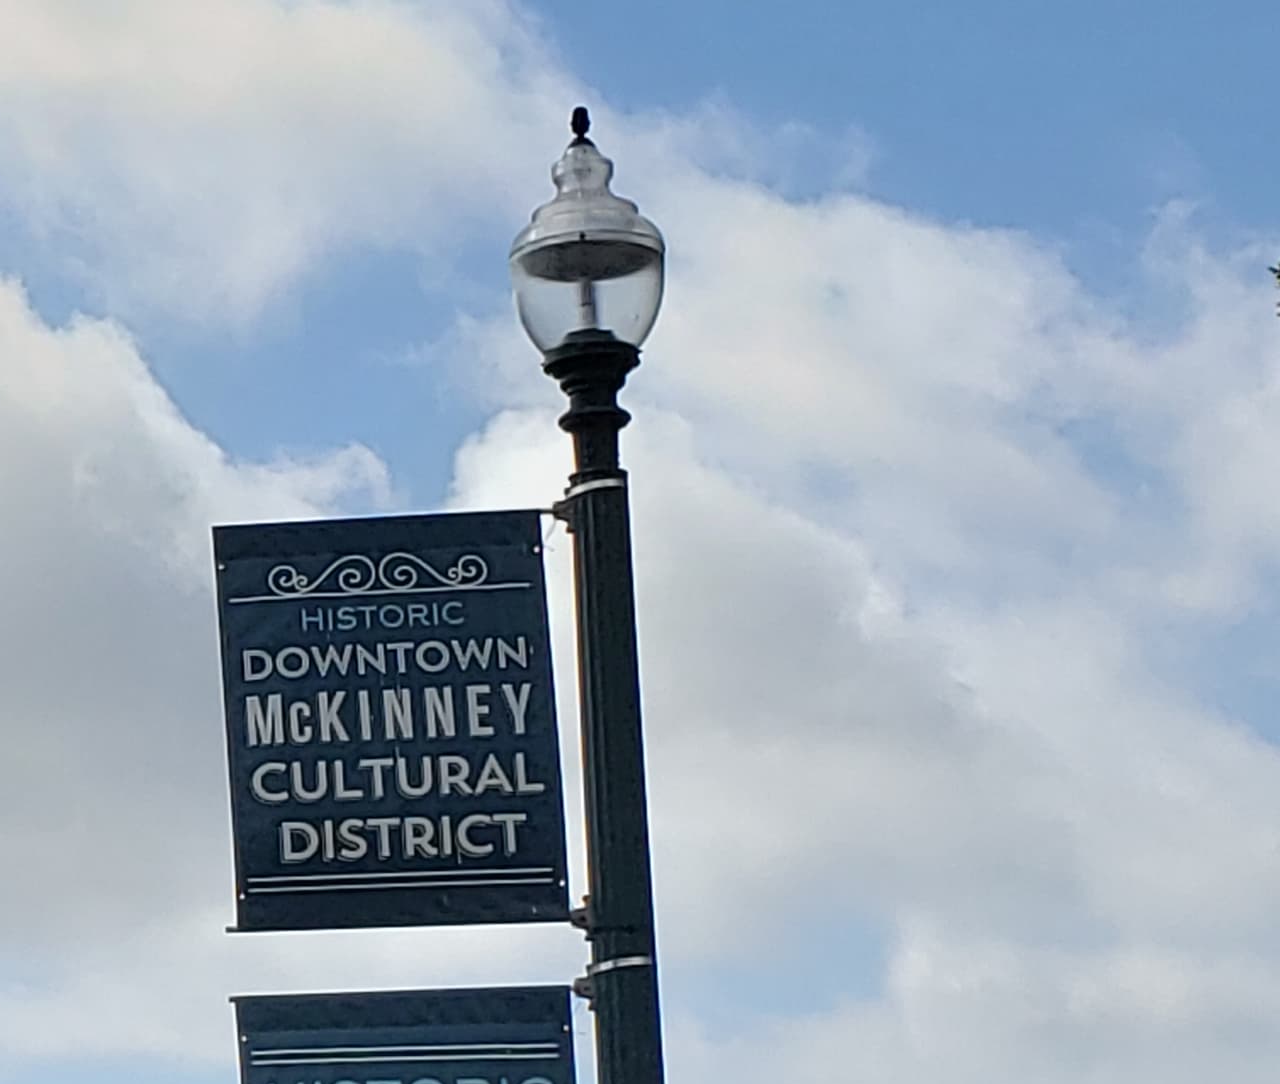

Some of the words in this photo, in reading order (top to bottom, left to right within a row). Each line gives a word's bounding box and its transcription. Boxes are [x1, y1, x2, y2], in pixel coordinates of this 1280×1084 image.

[300, 601, 465, 632] HISTORIC
[242, 636, 528, 681] DOWNTOWN
[244, 683, 532, 747] McKINNEY
[251, 752, 545, 802] CULTURAL
[279, 812, 528, 863] DISTRICT
